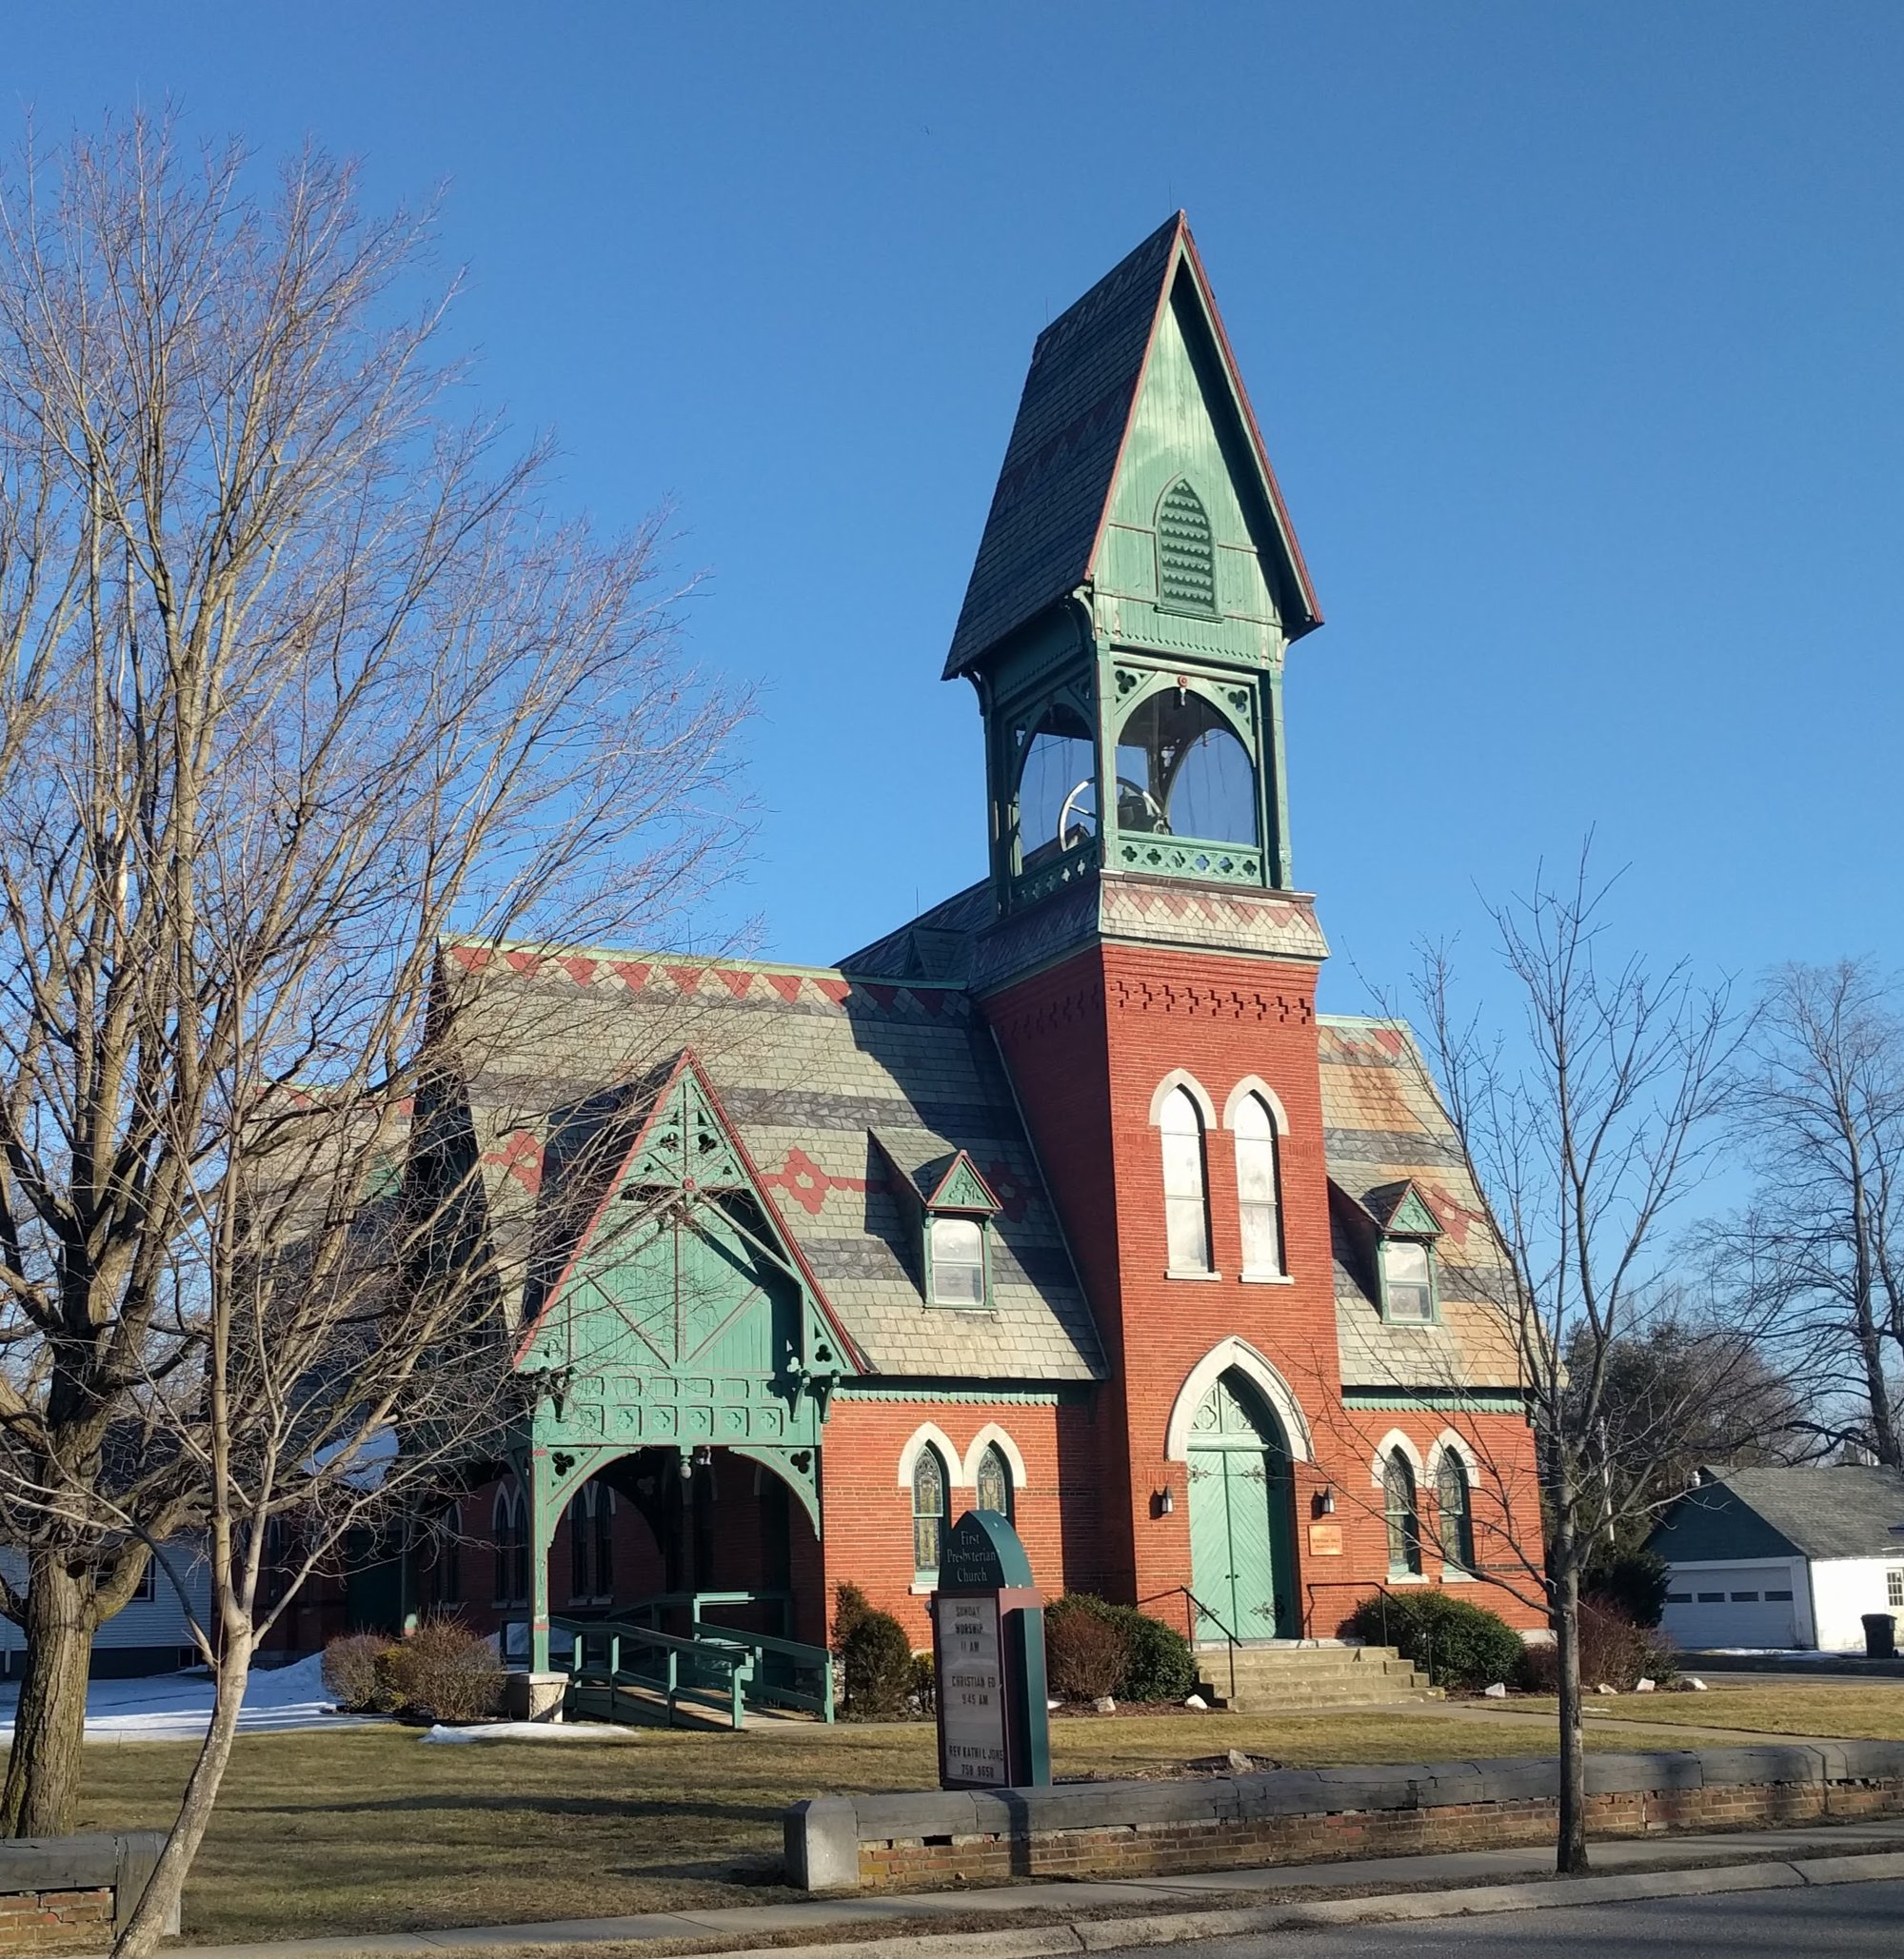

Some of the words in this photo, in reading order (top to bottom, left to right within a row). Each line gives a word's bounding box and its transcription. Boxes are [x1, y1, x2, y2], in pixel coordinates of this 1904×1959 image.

[961, 1531, 980, 1546] First
[947, 1548, 996, 1563] Presbyterian
[957, 1567, 987, 1582] Church
[956, 1606, 981, 1617] SUNDAY
[955, 1622, 982, 1634] WORSHIP
[969, 1641, 980, 1652] AM
[952, 1675, 984, 1688] CHRISTIAN
[987, 1676, 996, 1688] ED
[979, 1694, 988, 1706] AM
[948, 1745, 961, 1757] REV
